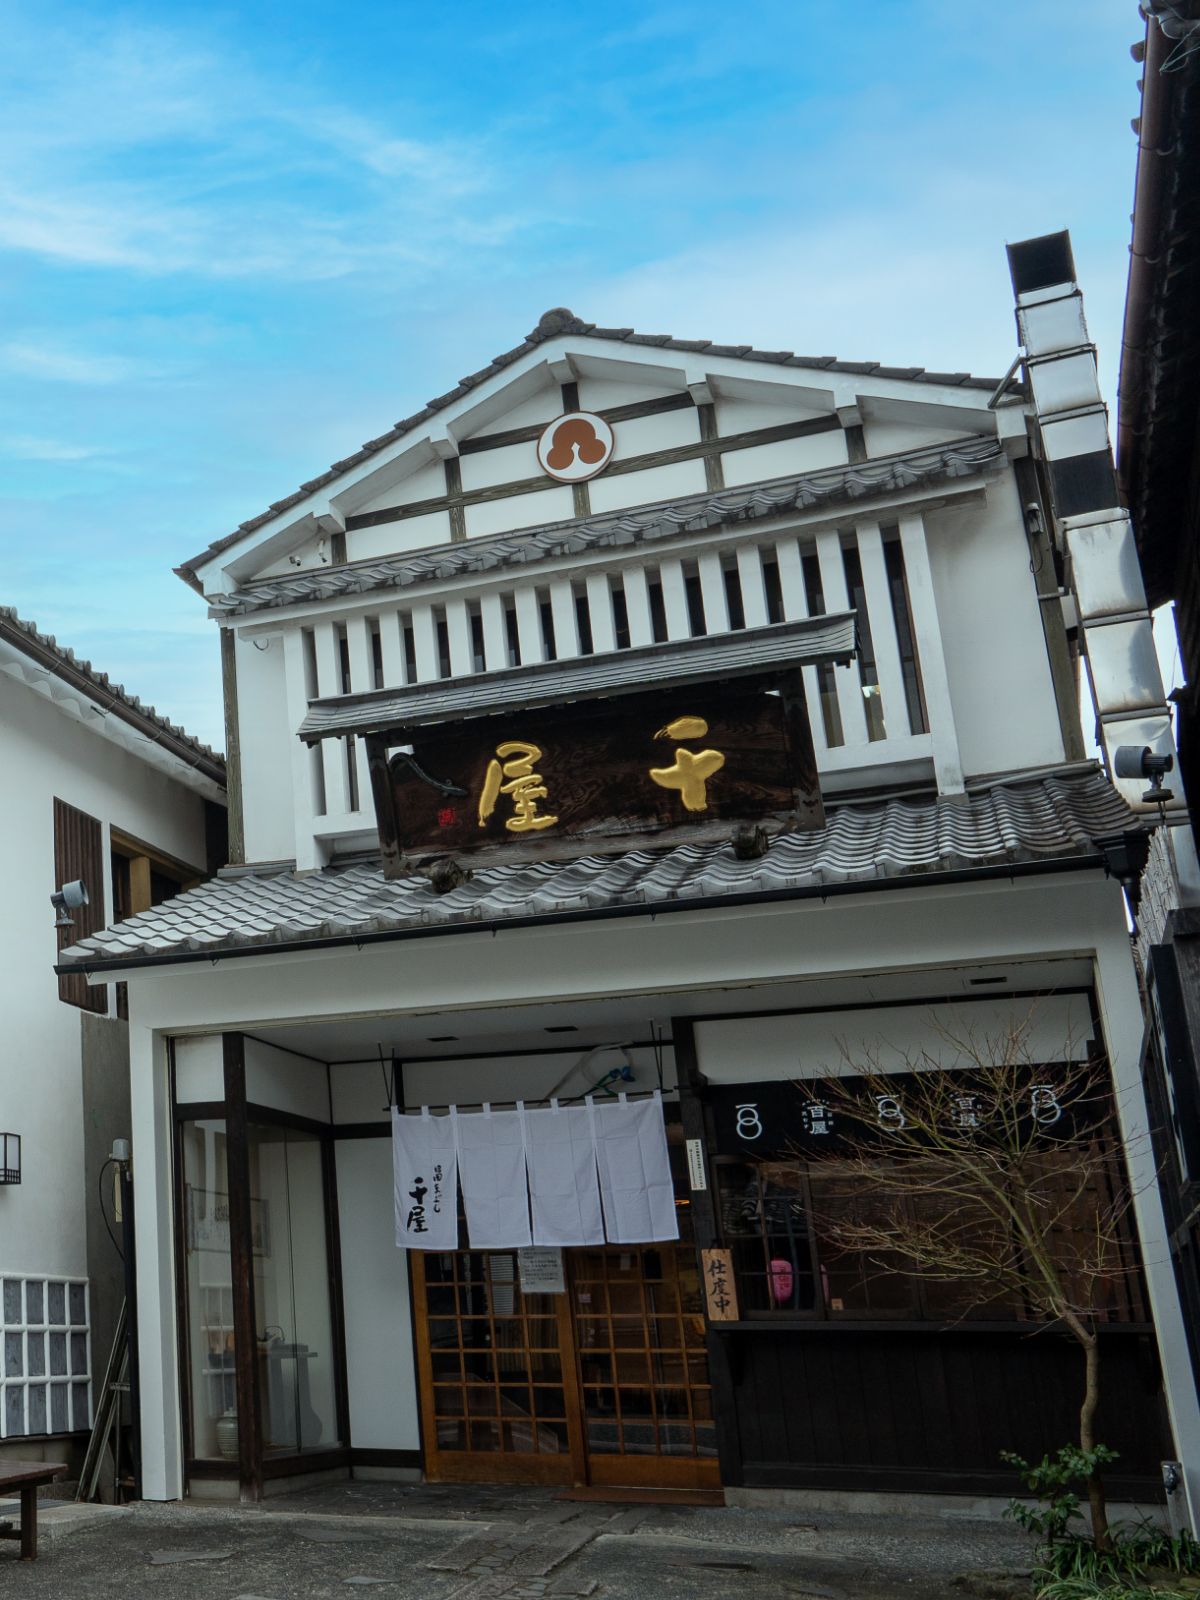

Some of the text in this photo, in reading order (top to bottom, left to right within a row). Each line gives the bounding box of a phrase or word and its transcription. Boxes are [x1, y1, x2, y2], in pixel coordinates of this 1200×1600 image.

[807, 1105, 829, 1134] 百屋
[407, 1176, 429, 1233] 千屋
[708, 1259, 731, 1314] 仕度中
